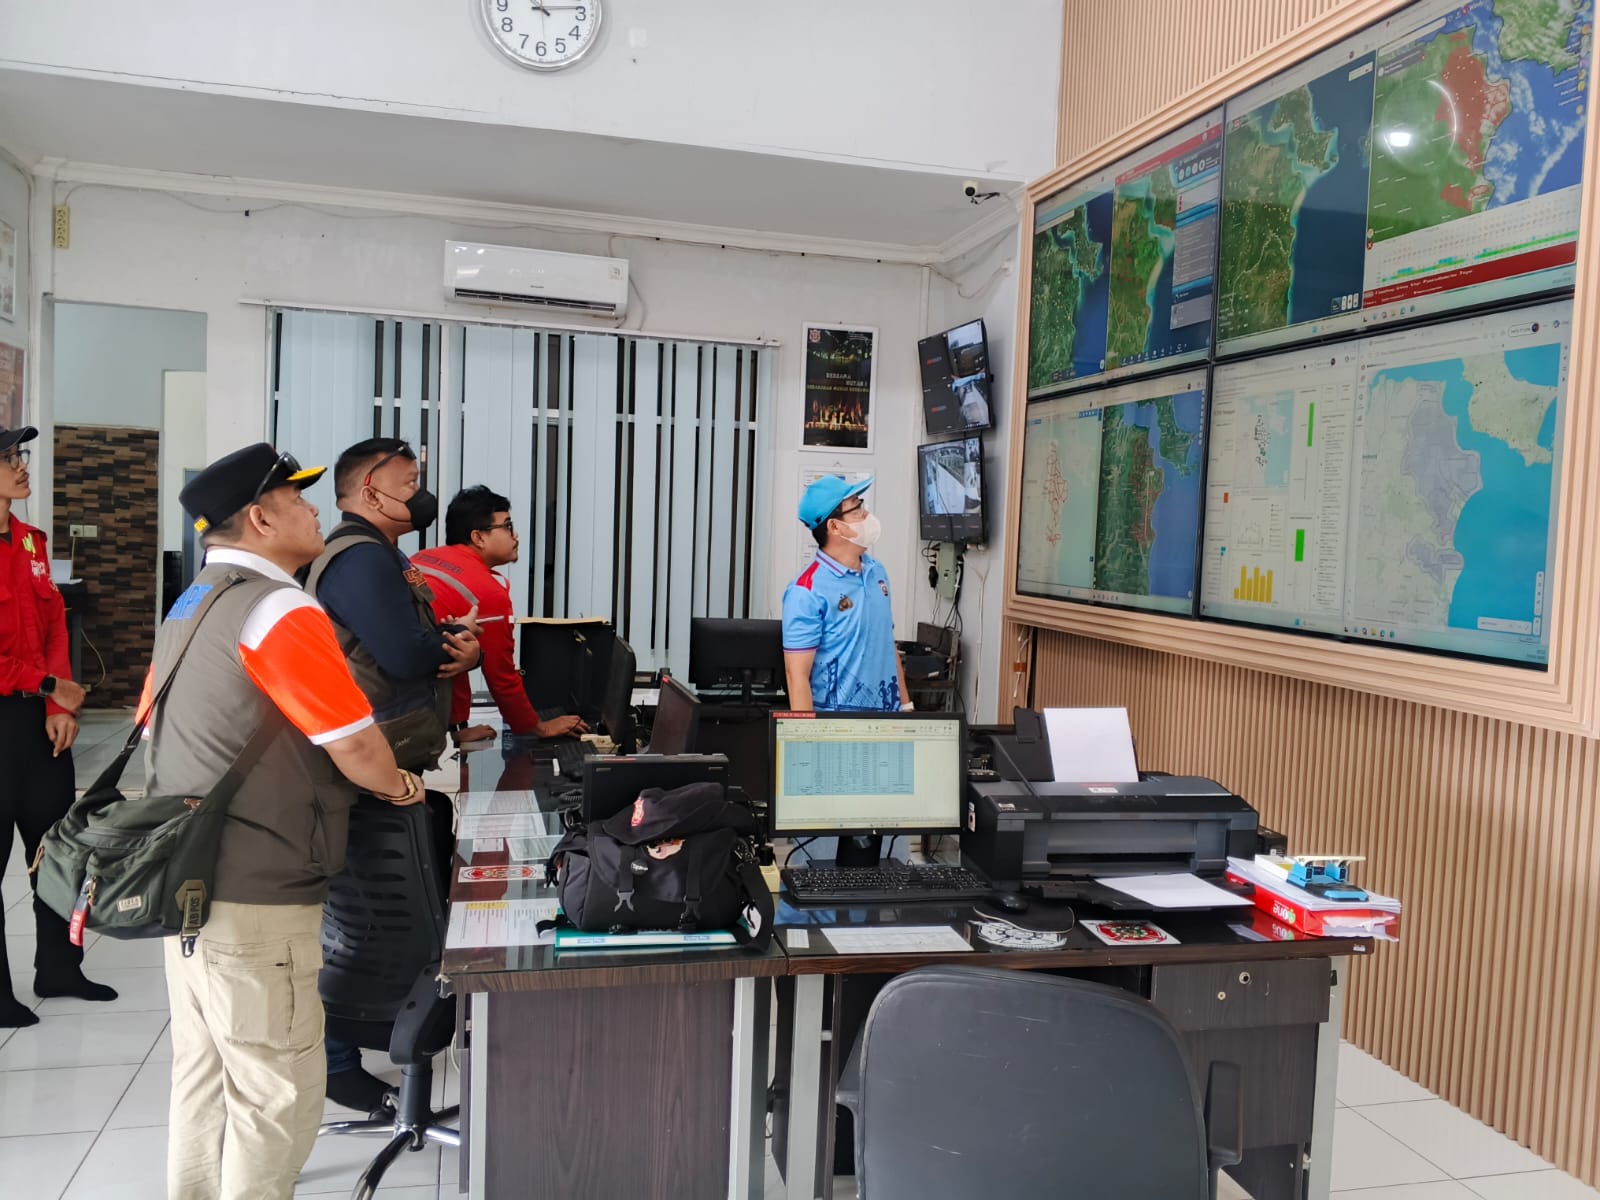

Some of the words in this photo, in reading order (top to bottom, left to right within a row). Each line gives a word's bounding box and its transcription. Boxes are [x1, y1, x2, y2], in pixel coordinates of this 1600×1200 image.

[496, 0, 508, 12] 9
[575, 6, 586, 21] 3
[501, 17, 513, 32] 8
[568, 25, 581, 40] 4
[519, 33, 529, 49] 7
[555, 38, 566, 53] 5
[535, 41, 547, 57] 6
